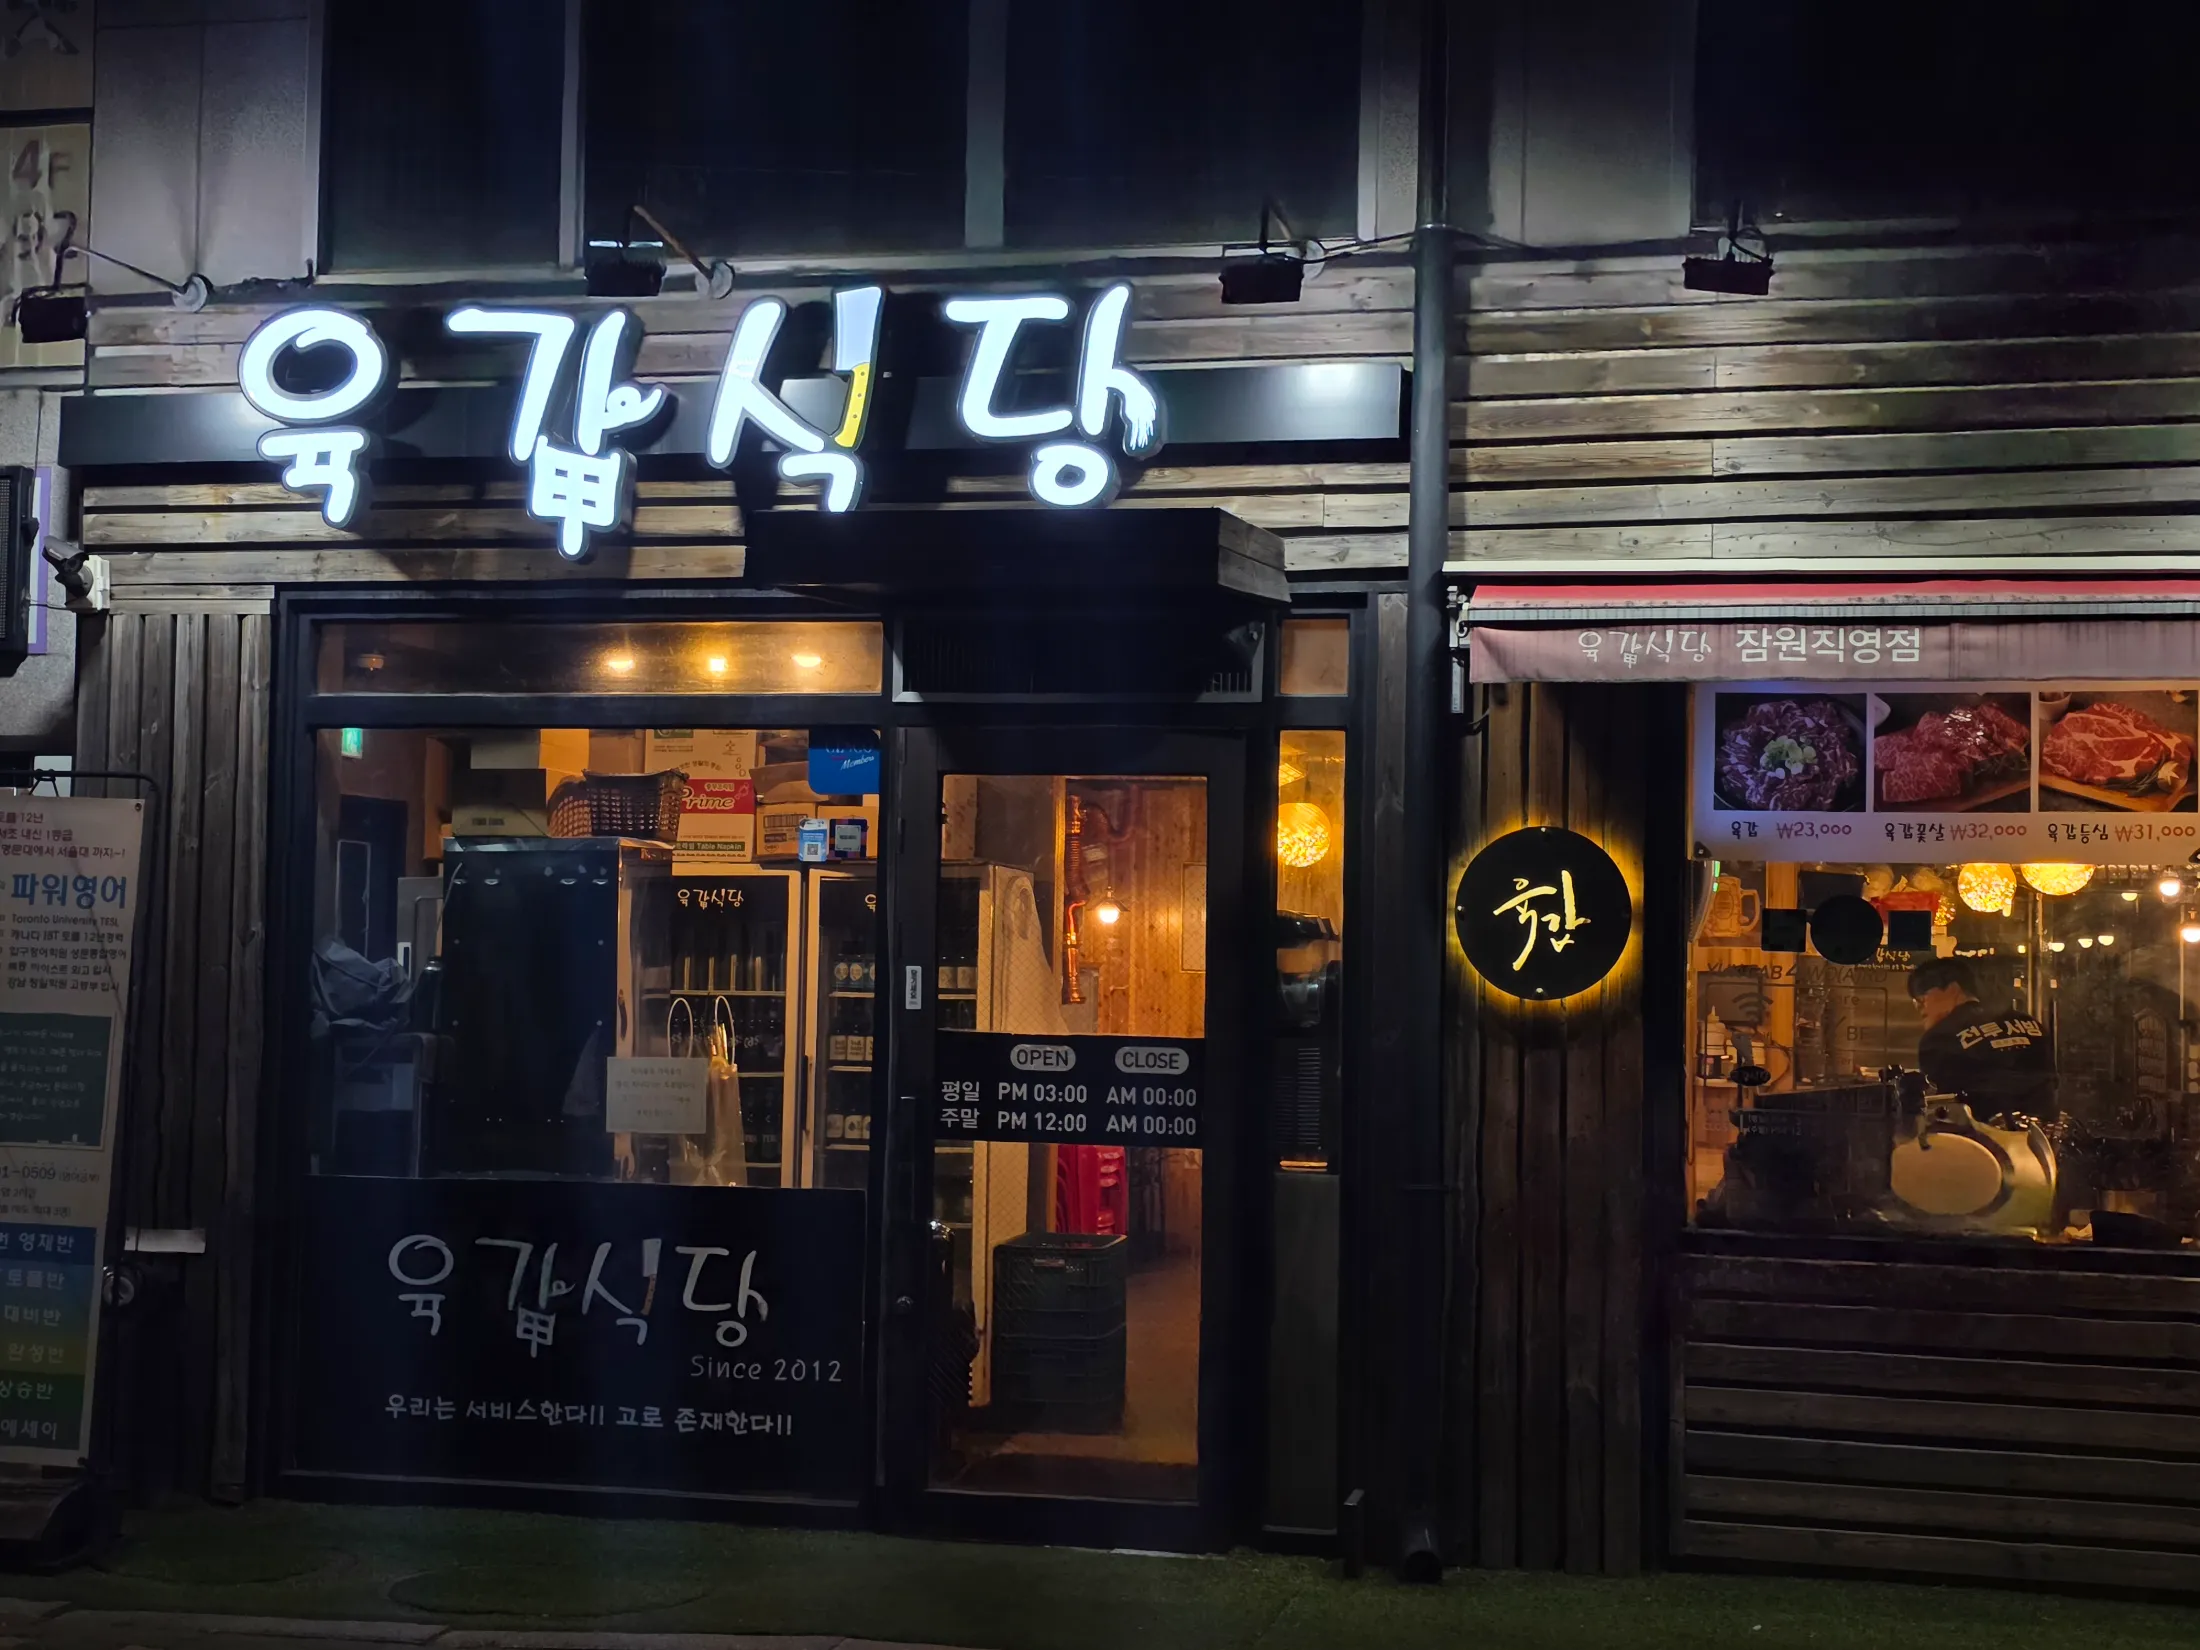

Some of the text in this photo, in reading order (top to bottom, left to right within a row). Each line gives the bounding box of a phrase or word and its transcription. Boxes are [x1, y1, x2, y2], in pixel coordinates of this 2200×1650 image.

[1577, 626, 1922, 669] 육갑식당 잠원직영점
[840, 754, 875, 770] Members
[681, 786, 735, 809] Prime
[21, 828, 42, 840] 내신
[1731, 819, 1759, 840] 육갑
[1885, 821, 1945, 842] 육갑꽃살
[2047, 822, 2109, 844] 육갑등심
[697, 842, 716, 850] Table
[717, 842, 742, 851] Napkin
[11, 873, 127, 909] 파워영어
[677, 888, 744, 911] 육갑식당
[12, 913, 50, 924] Toronto
[1493, 869, 1590, 972] 육갑
[1956, 1021, 2003, 1050] 전투
[2004, 1018, 2043, 1037] 서빙
[1016, 1049, 1181, 1070] OPEN CLOSE
[941, 1081, 1197, 1107] 평일 PM 03:00 AM 00:00
[940, 1108, 1197, 1136] 주말 PM 12:00 AM 00:00
[18, 1232, 75, 1254] 영재반
[388, 1234, 769, 1358] 육갑식당
[4, 1304, 62, 1327] 대비반
[690, 1355, 843, 1383] Since 2012
[385, 1395, 457, 1420] 우리는
[616, 1404, 664, 1428] 고로
[0, 1418, 57, 1441] 에세이
